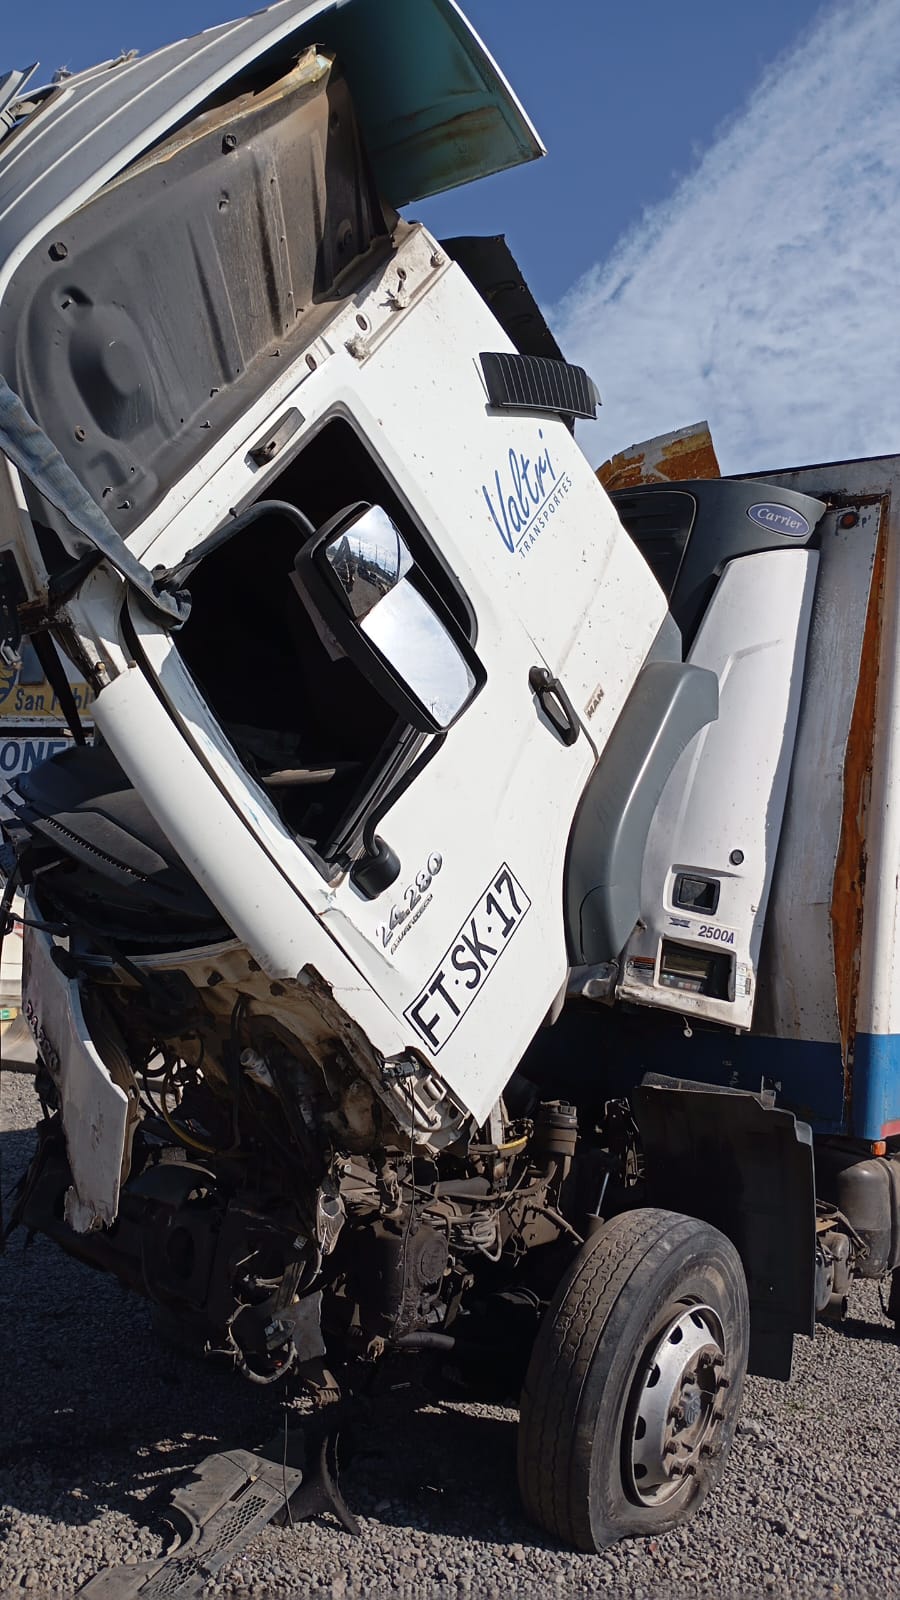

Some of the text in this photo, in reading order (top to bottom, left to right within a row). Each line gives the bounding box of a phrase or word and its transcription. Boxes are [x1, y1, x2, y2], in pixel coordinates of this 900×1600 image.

[482, 428, 556, 553] Valtri
[518, 476, 573, 558] TRANSPORTES
[757, 508, 802, 529] Carrier
[15, 687, 45, 711] San
[697, 925, 735, 944] 2500A
